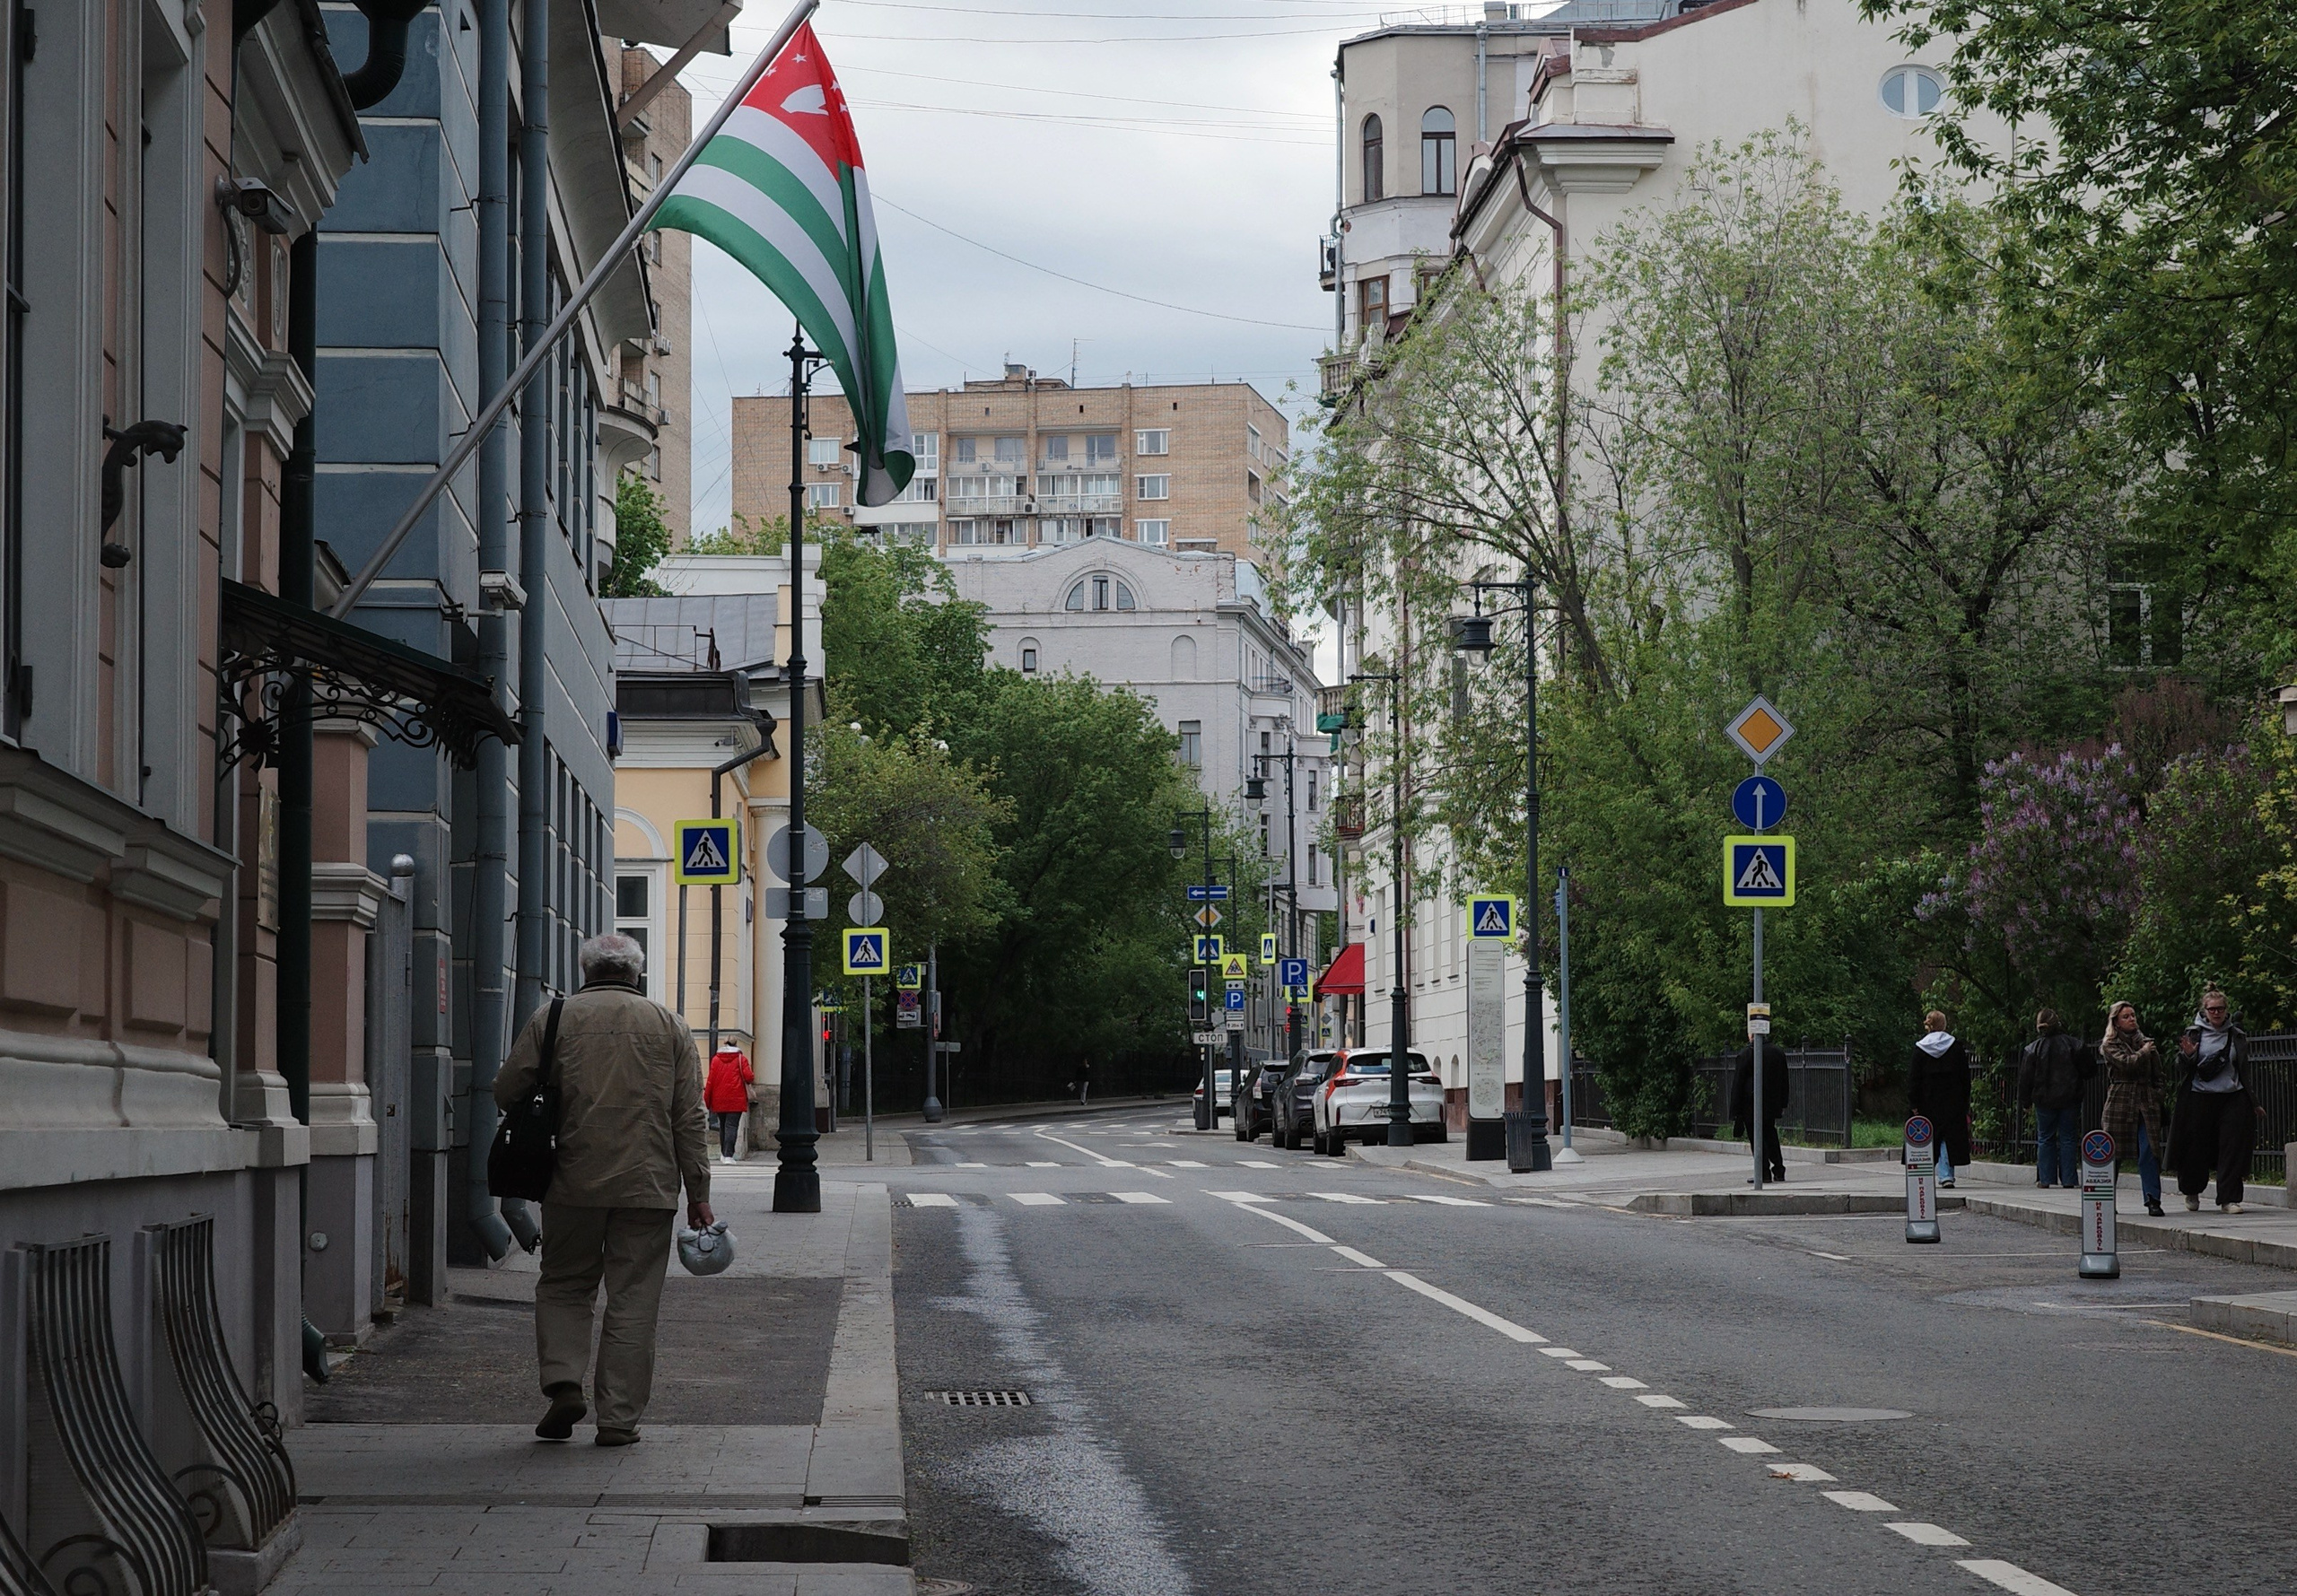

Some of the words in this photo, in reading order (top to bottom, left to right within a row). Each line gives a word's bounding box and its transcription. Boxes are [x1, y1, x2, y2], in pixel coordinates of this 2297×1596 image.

[1288, 962, 1303, 983] P
[1197, 990, 1204, 1000] 4
[1230, 992, 1241, 1007] P
[1198, 1033, 1223, 1042] СТОП
[2096, 1201, 2101, 1210] НЕ
